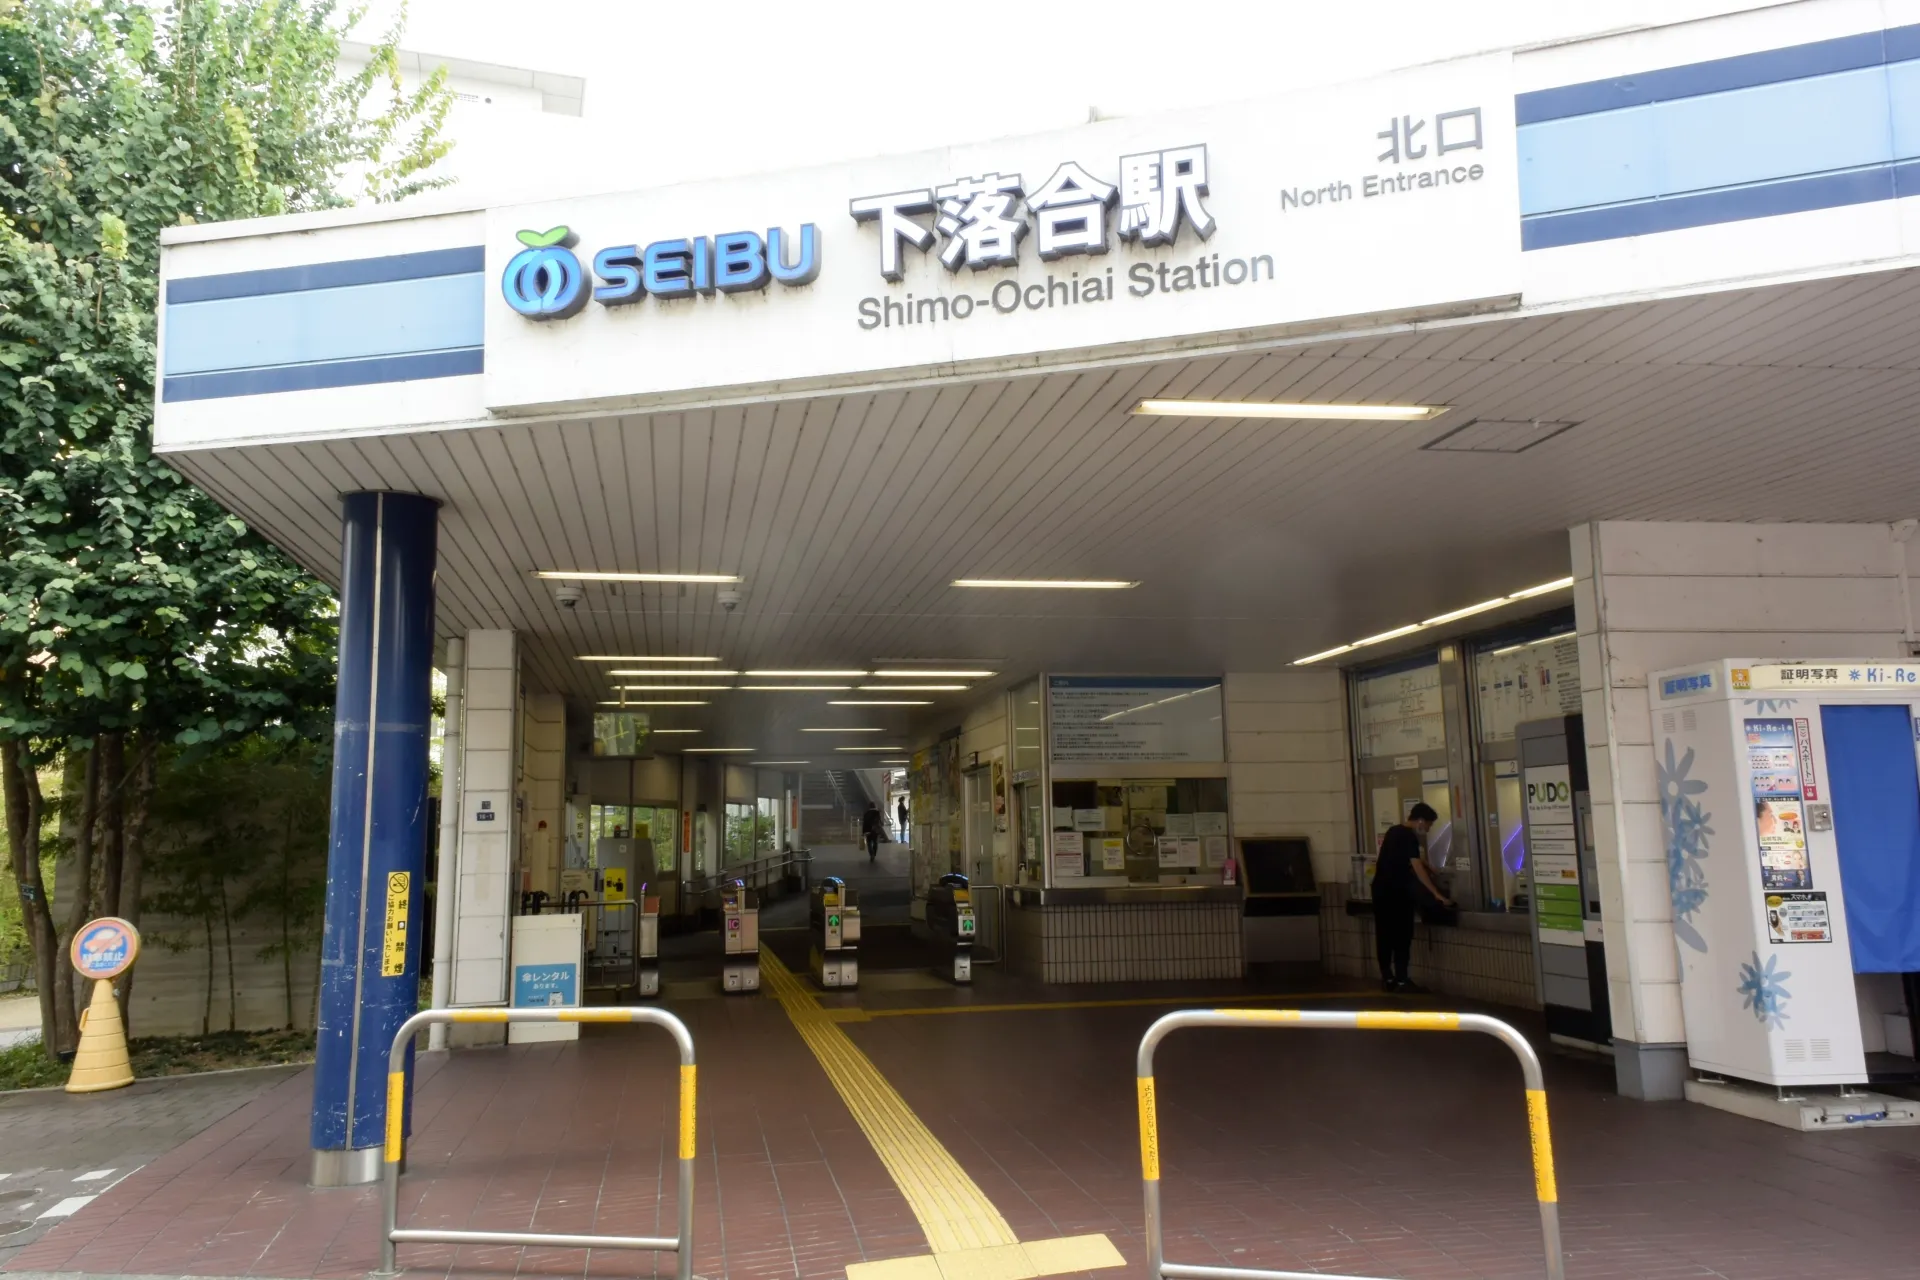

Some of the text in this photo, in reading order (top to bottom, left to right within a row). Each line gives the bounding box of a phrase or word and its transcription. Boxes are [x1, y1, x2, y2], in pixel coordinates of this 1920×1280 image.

[1375, 107, 1484, 164] 北口
[1281, 164, 1484, 211] North Entrance
[849, 143, 1214, 282] 下落合駅
[593, 224, 820, 306] SEIBU
[857, 251, 1275, 330] Shimo-Ochiai Station
[1780, 669, 1839, 680] 証明写真
[1867, 668, 1916, 682] Ki-Re
[1509, 762, 1516, 774] 2
[1527, 781, 1569, 803] PUDO
[728, 919, 739, 929] IC
[522, 971, 570, 983] 傘レンタル
[533, 982, 559, 990] あります。
